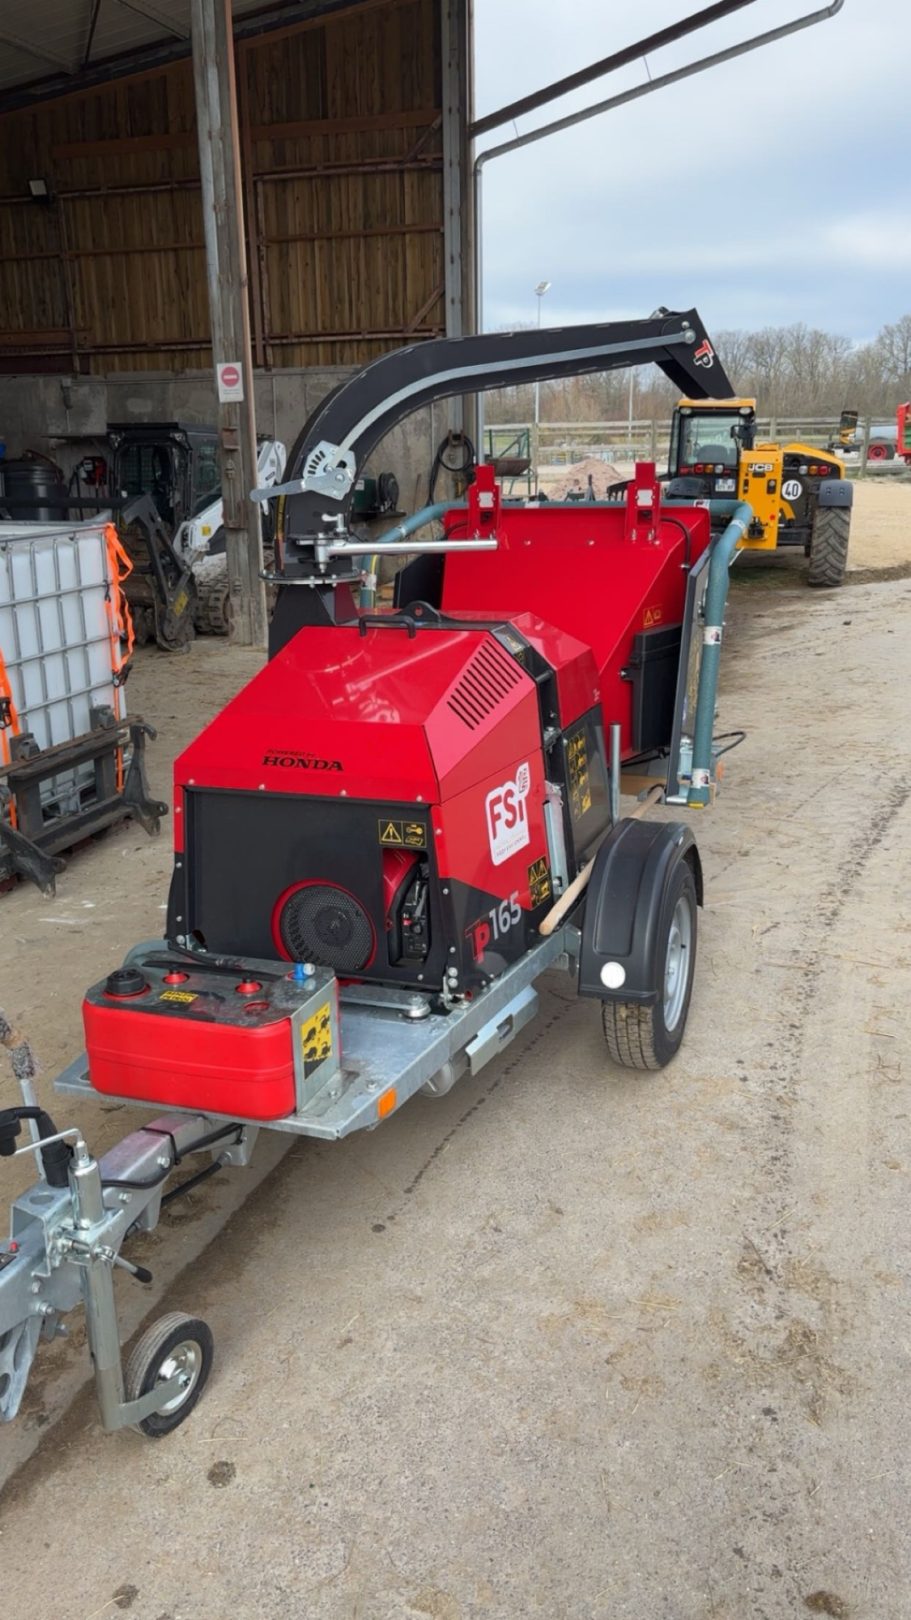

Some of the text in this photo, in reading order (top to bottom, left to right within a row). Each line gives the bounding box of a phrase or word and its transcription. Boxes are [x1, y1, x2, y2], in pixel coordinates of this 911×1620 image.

[748, 464, 773, 472] JCB
[785, 483, 799, 497] 40
[262, 756, 344, 771] HONDA
[489, 890, 522, 940] 165
